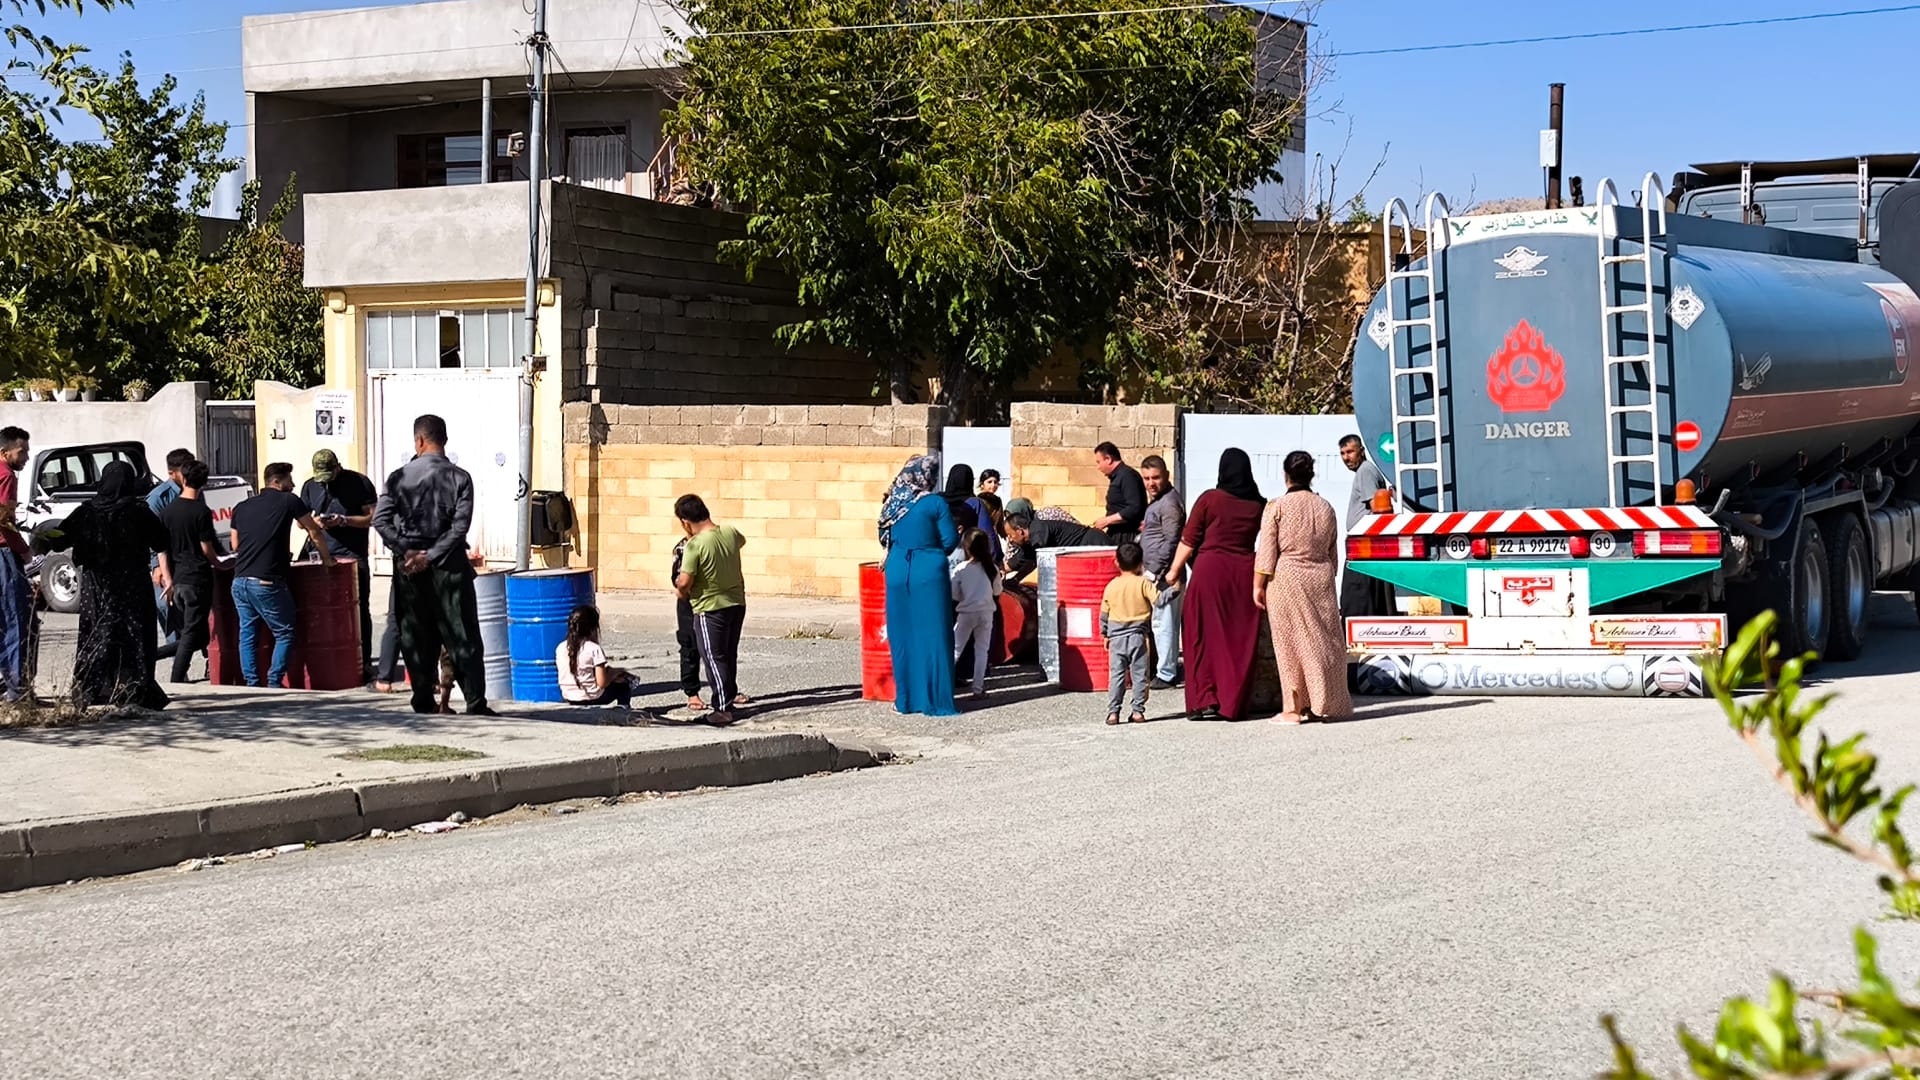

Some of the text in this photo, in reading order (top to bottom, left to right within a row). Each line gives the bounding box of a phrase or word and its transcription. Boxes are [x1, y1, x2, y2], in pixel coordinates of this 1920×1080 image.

[1495, 269, 1548, 279] 2020
[1485, 421, 1571, 440] DANGER
[1450, 539, 1466, 552] 80
[1499, 538, 1567, 553] 22 A 99174
[1594, 537, 1610, 550] 90
[1452, 663, 1598, 690] Mercedes
